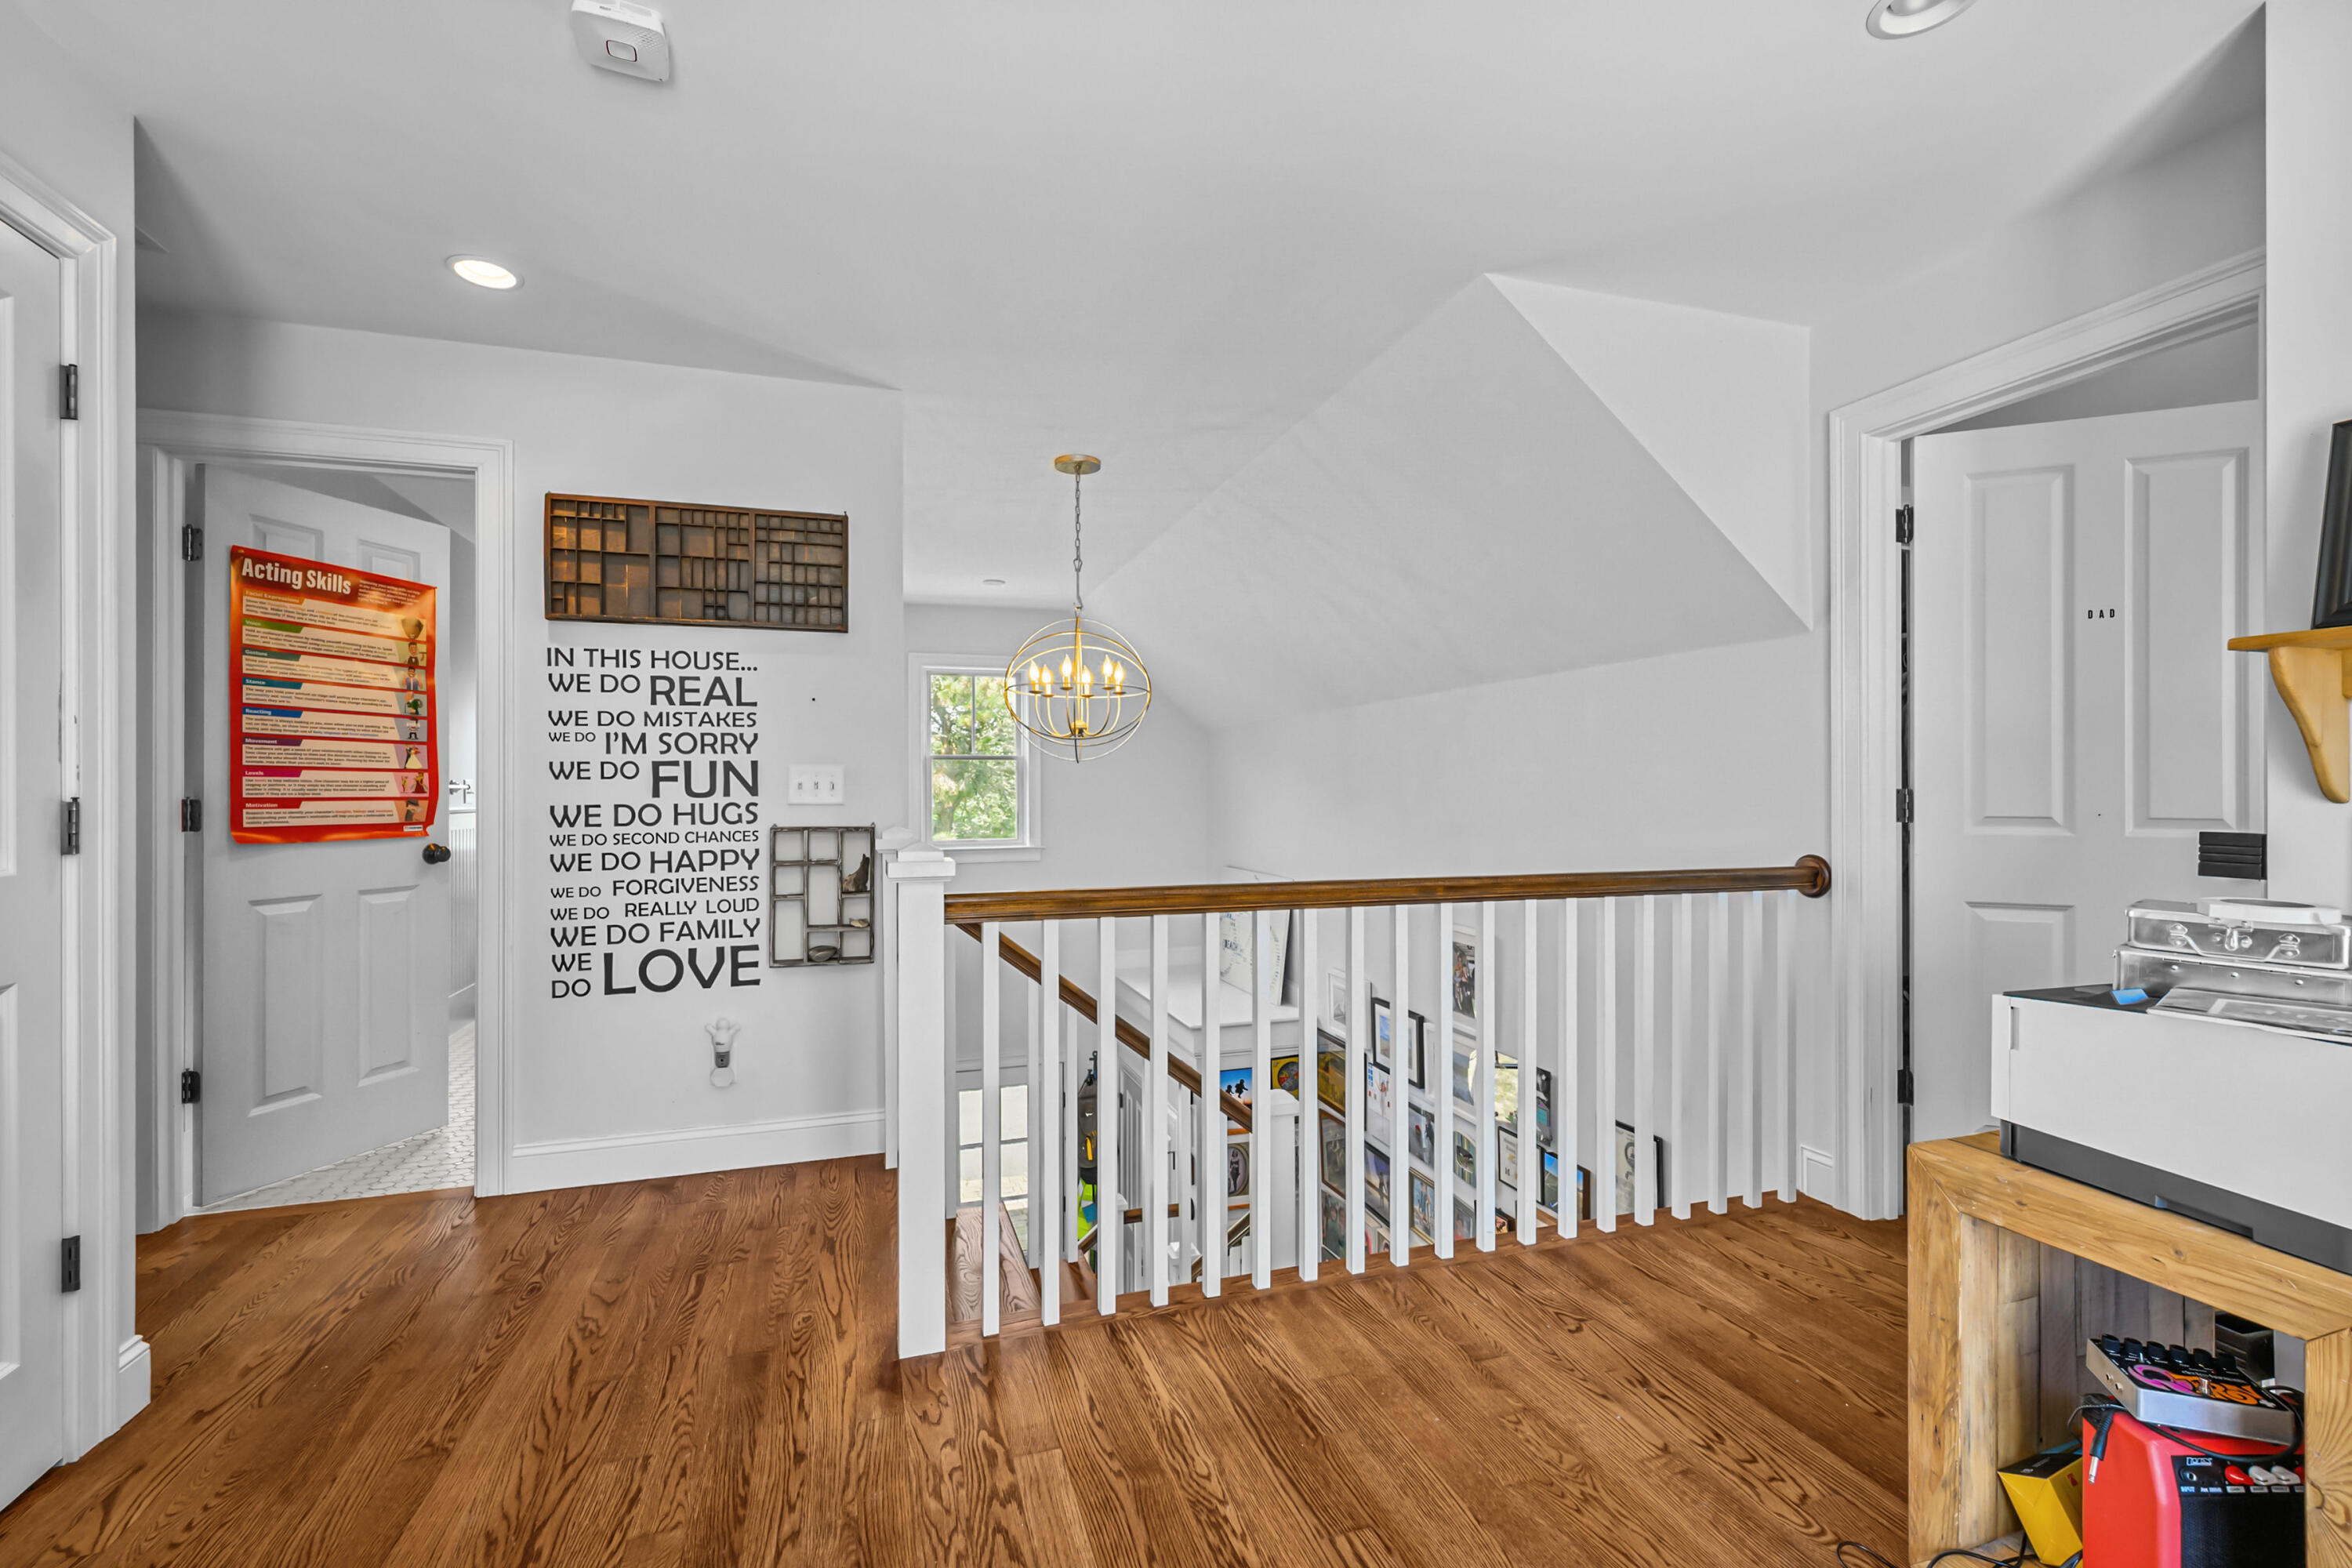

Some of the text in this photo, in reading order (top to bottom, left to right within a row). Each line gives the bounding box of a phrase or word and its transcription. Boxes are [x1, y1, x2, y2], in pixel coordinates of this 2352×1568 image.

[241, 558, 303, 590] Acting
[306, 569, 351, 595] Skills
[2088, 608, 2115, 619] DAD
[547, 648, 573, 666] IN
[584, 648, 641, 668] THIS
[549, 673, 757, 706] WE DO REAL
[548, 710, 757, 727] WE DO MISTAKES
[549, 732, 570, 742] WE
[575, 732, 595, 742] DO
[659, 732, 758, 754] SORRY
[550, 760, 758, 798] WE DO FUN
[550, 803, 758, 828] WE DO HUGS
[550, 830, 758, 846] WE DO SECOND CHANCES
[550, 849, 759, 873] WE DO HAPPY
[551, 876, 759, 898] WE DO FORGIVENESS
[550, 898, 759, 920] WE DO REALLY LOUD
[551, 918, 760, 947] WE DO FAMILY
[552, 953, 591, 972] WE
[552, 945, 760, 998] DO LOVE
